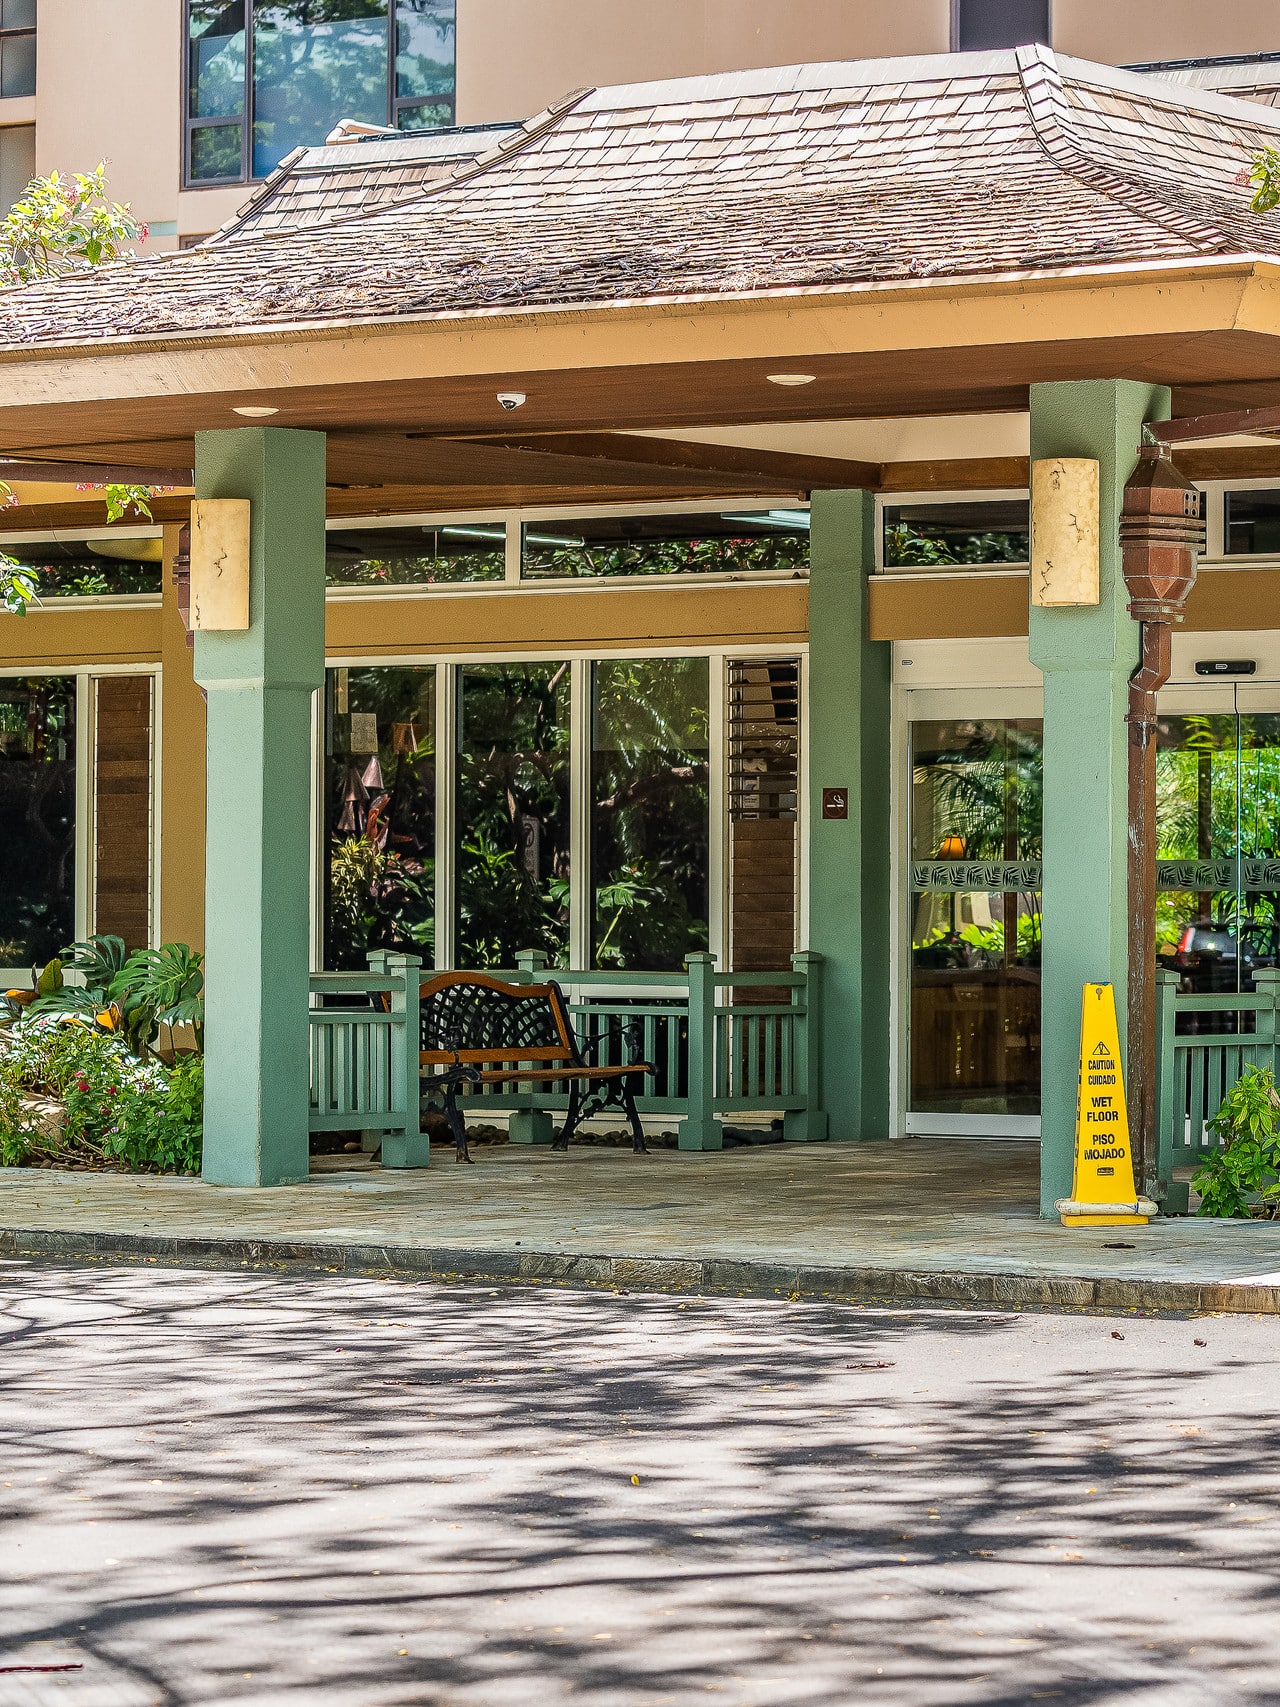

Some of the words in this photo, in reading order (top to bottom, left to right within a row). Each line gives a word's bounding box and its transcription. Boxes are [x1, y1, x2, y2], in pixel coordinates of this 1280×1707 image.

[1088, 1059, 1115, 1070] CAUTION
[1088, 1074, 1116, 1085] CUIDADO
[1091, 1096, 1112, 1107] WET
[1087, 1111, 1119, 1122] FLOOR
[1092, 1133, 1115, 1145] PISO
[1084, 1148, 1125, 1160] MOJADO
